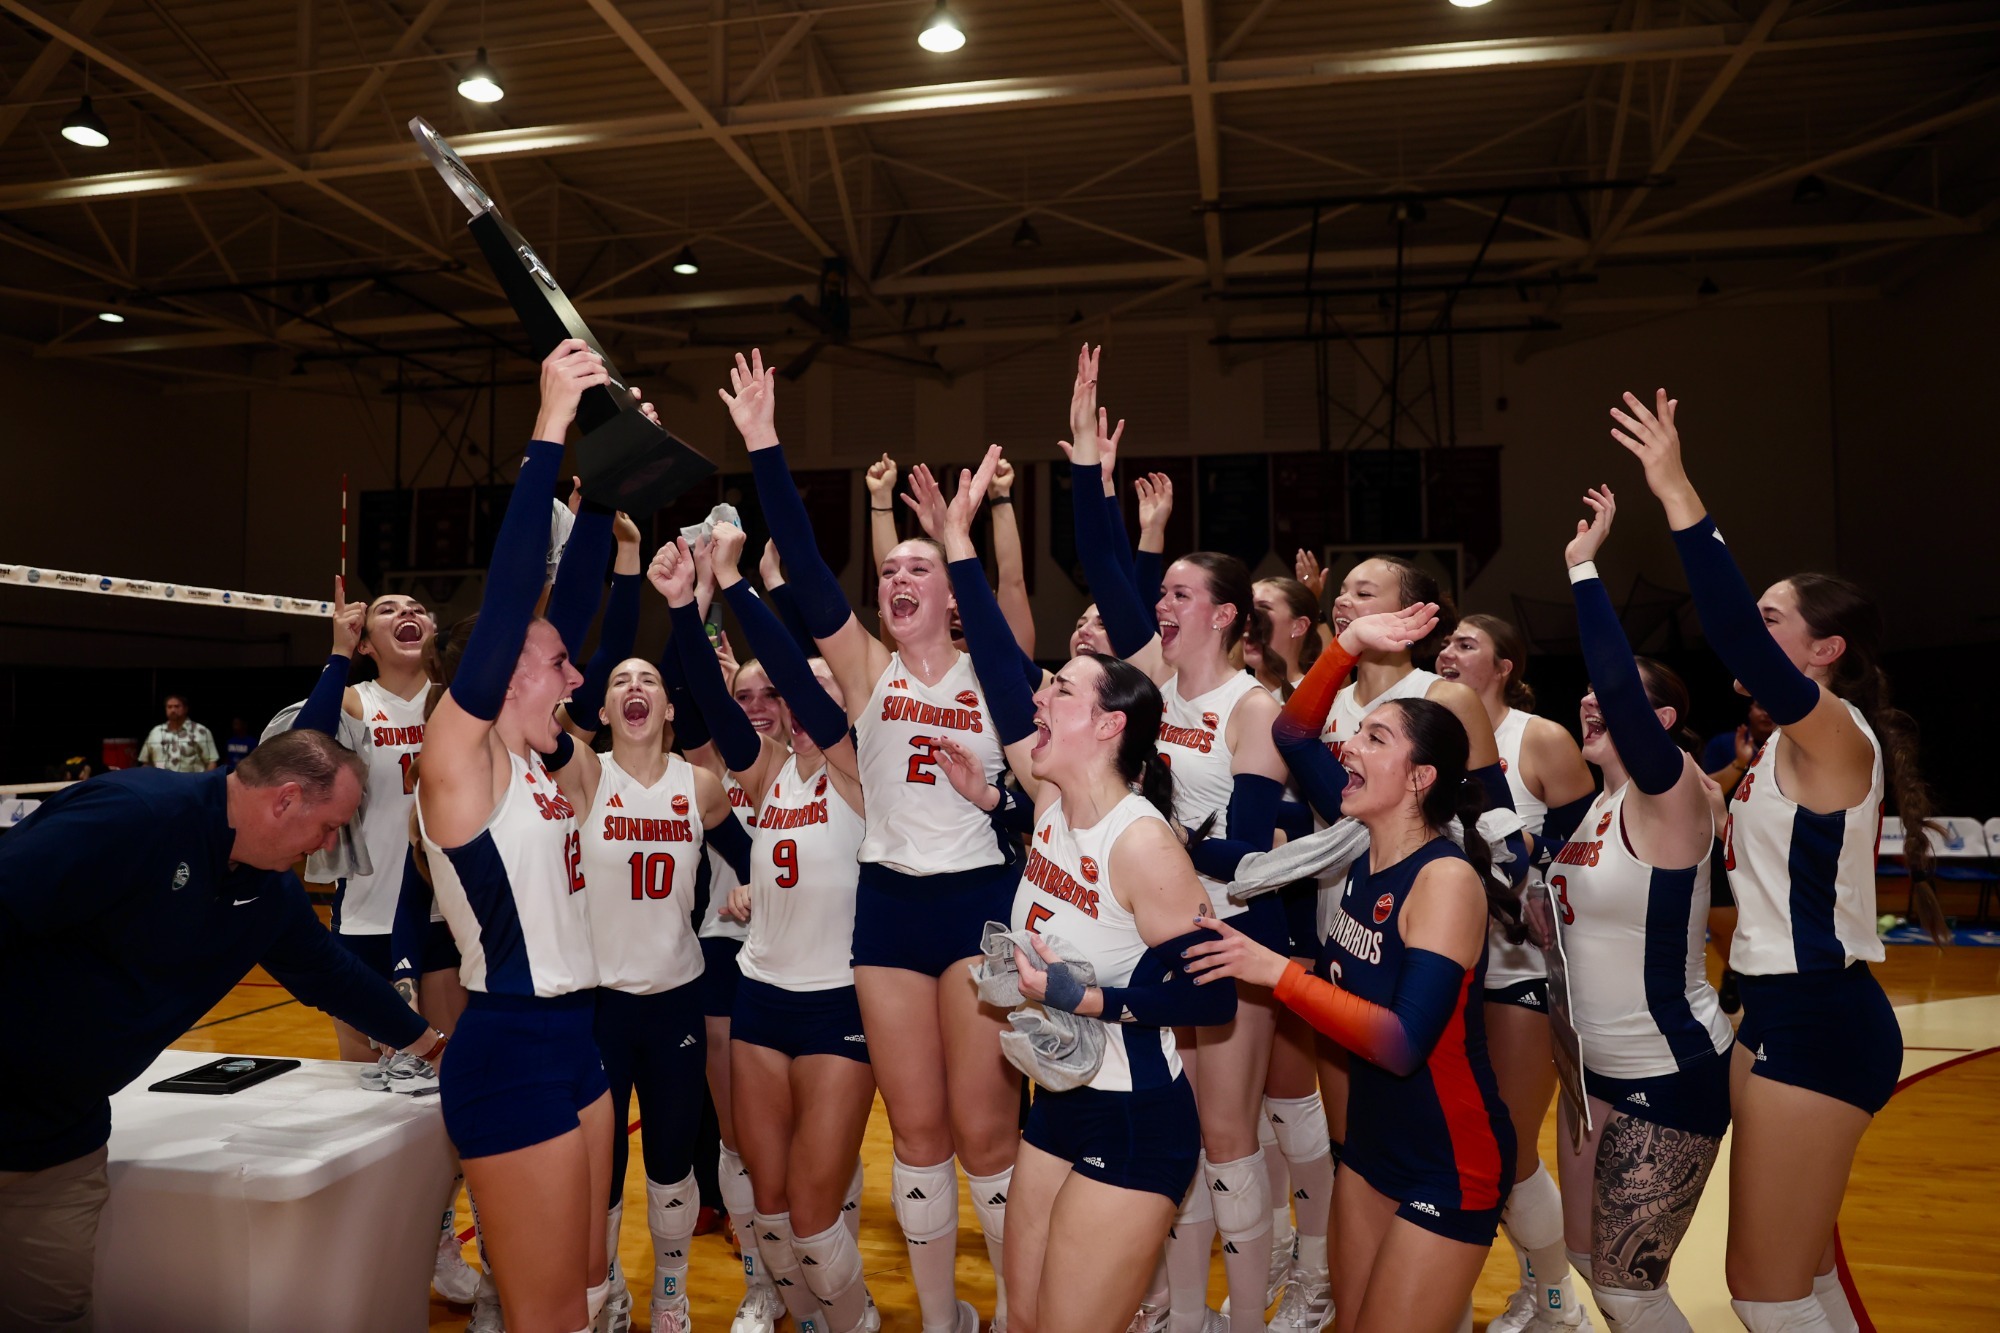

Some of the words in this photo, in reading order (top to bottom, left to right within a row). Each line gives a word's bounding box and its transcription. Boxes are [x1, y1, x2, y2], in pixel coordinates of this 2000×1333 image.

[56, 574, 86, 583] PacWest
[881, 695, 983, 733] SUNBIRDS
[906, 735, 941, 786] 2
[603, 815, 693, 842] SUNBIRDS
[564, 829, 586, 895] 12
[628, 851, 675, 900] 10
[773, 838, 799, 888] 9
[1626, 1096, 1650, 1108] adidas
[1410, 1202, 1441, 1218] adidas
